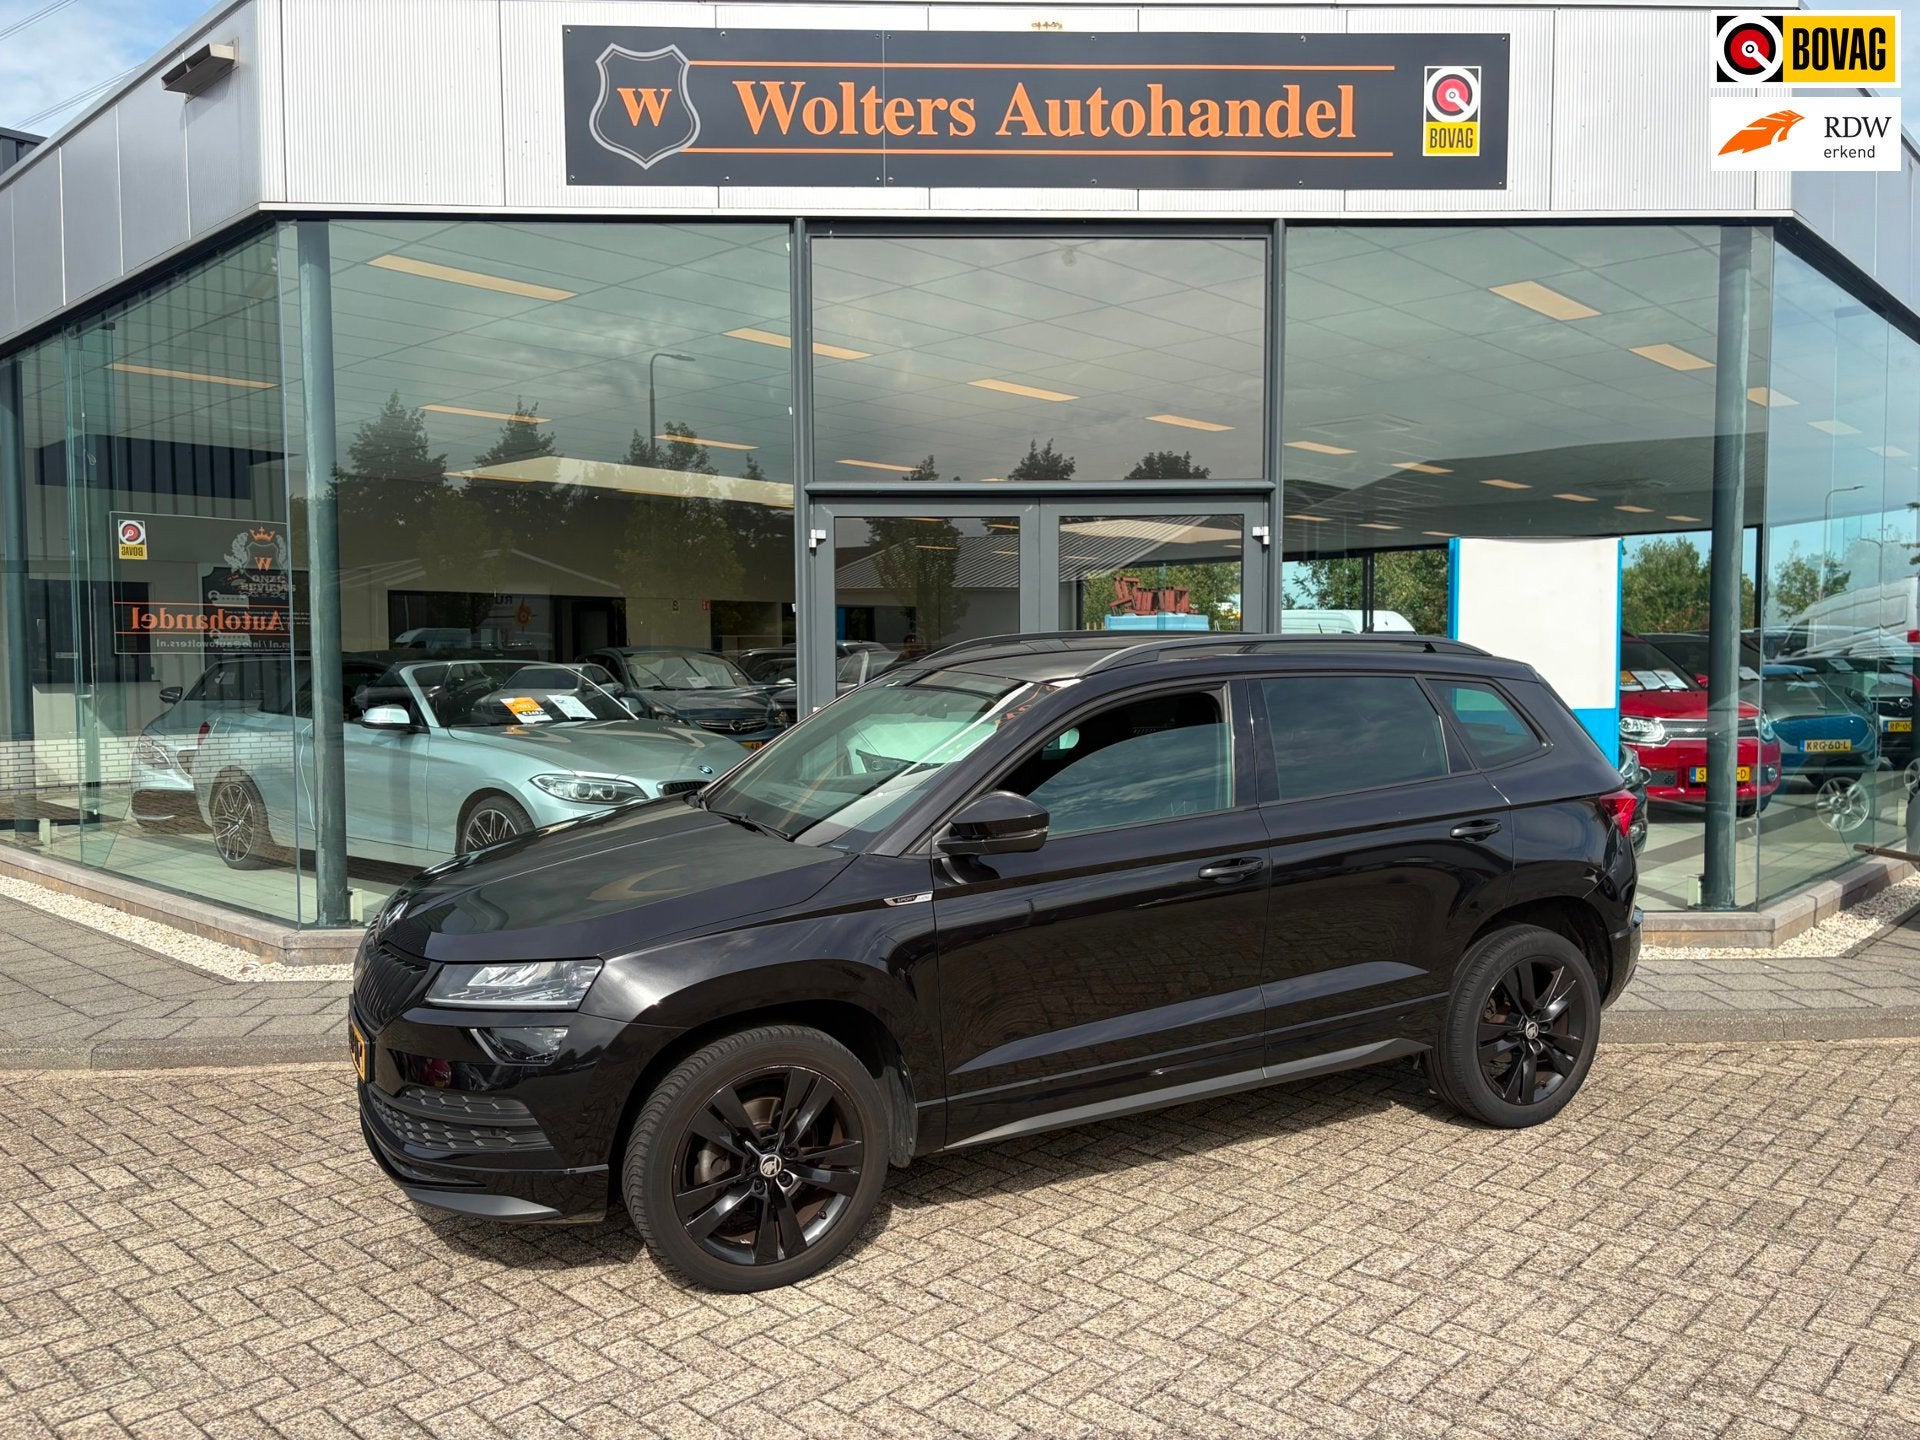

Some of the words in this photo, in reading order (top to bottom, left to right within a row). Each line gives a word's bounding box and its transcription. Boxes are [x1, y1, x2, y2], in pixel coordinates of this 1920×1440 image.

[616, 87, 672, 126] W
[732, 80, 976, 137] Wolters
[995, 82, 1356, 138] Autohandel
[1429, 127, 1473, 149] BOVAG
